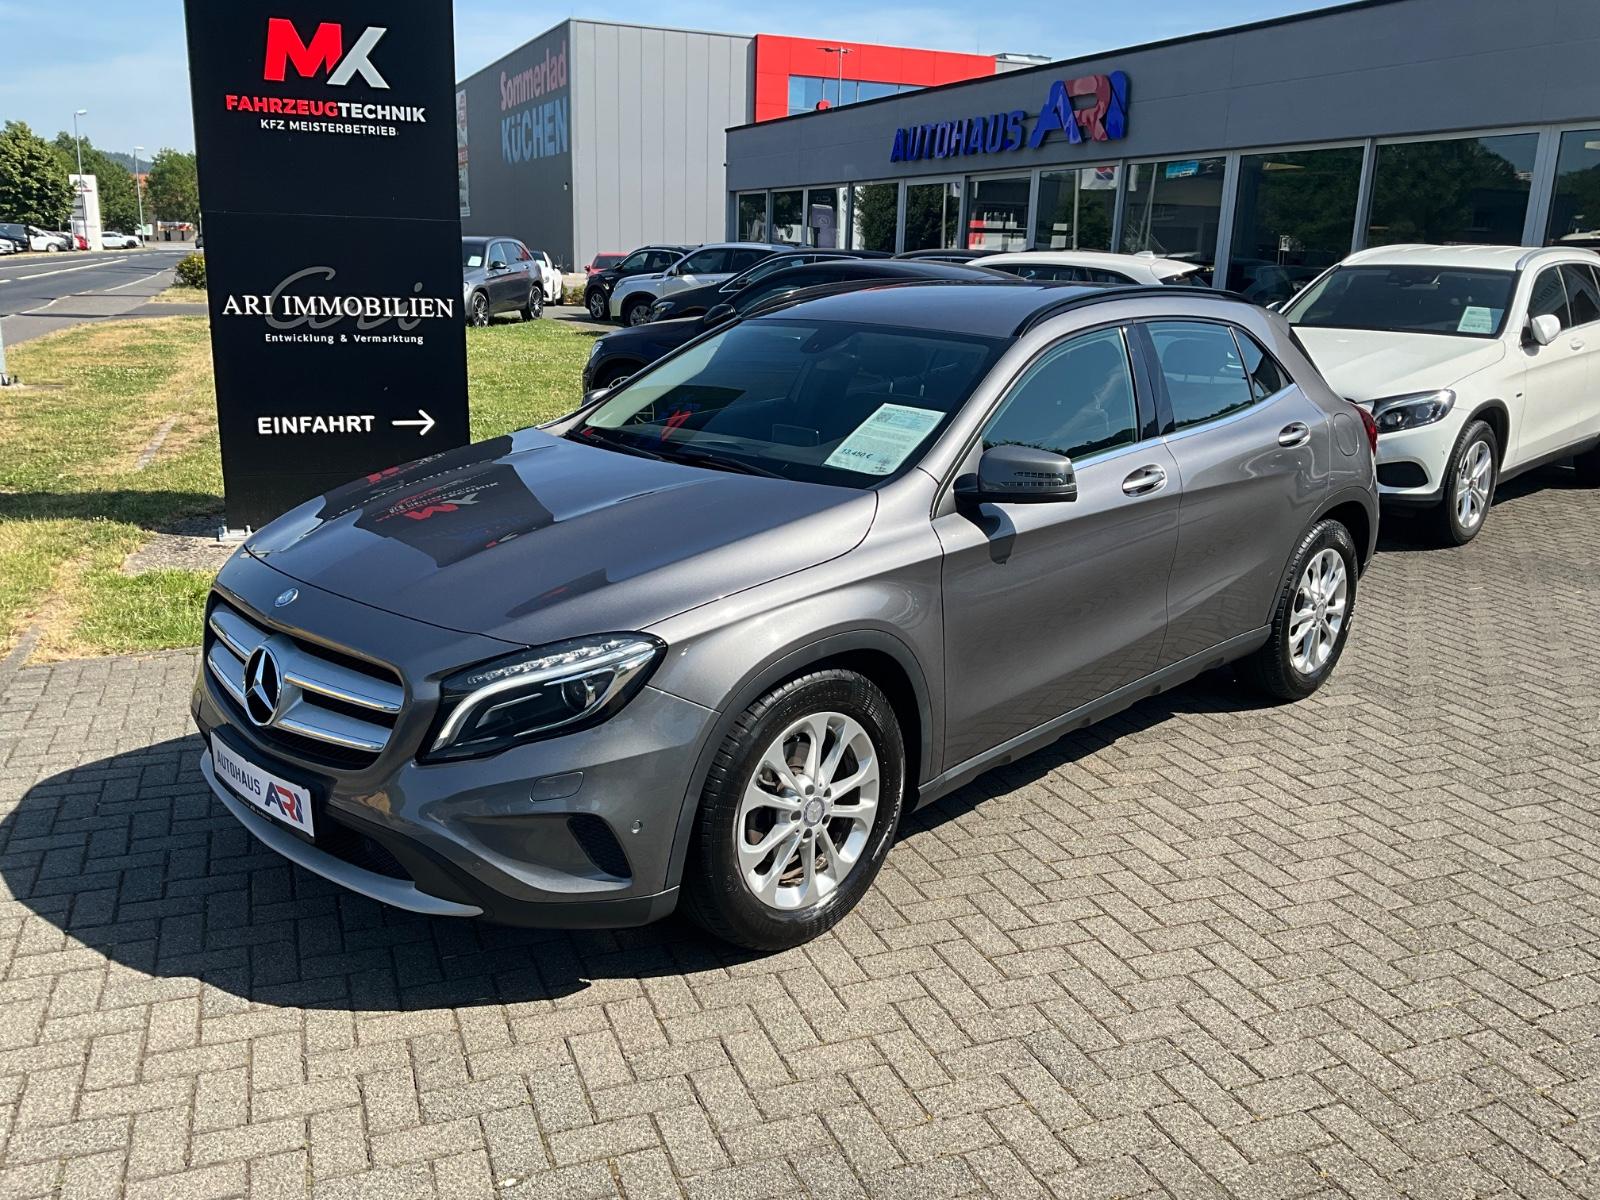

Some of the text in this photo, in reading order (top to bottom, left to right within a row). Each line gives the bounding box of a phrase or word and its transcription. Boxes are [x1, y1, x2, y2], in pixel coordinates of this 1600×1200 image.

[263, 17, 391, 90] MK
[500, 39, 567, 111] Sommerlad
[225, 94, 427, 123] FAHRZEUGTECHNIK
[260, 118, 397, 136] KFZ MEISTERBETRIEB
[501, 95, 568, 163] KÜCHEN
[890, 70, 1131, 163] AUTOHAUS ARI
[222, 294, 454, 318] ARI IMMOBILIEN
[265, 333, 424, 345] Entwicklung & Vermarktung
[257, 415, 375, 434] EINFAHRT
[217, 750, 261, 796] AUTOHAUS
[264, 781, 304, 825] ARI
